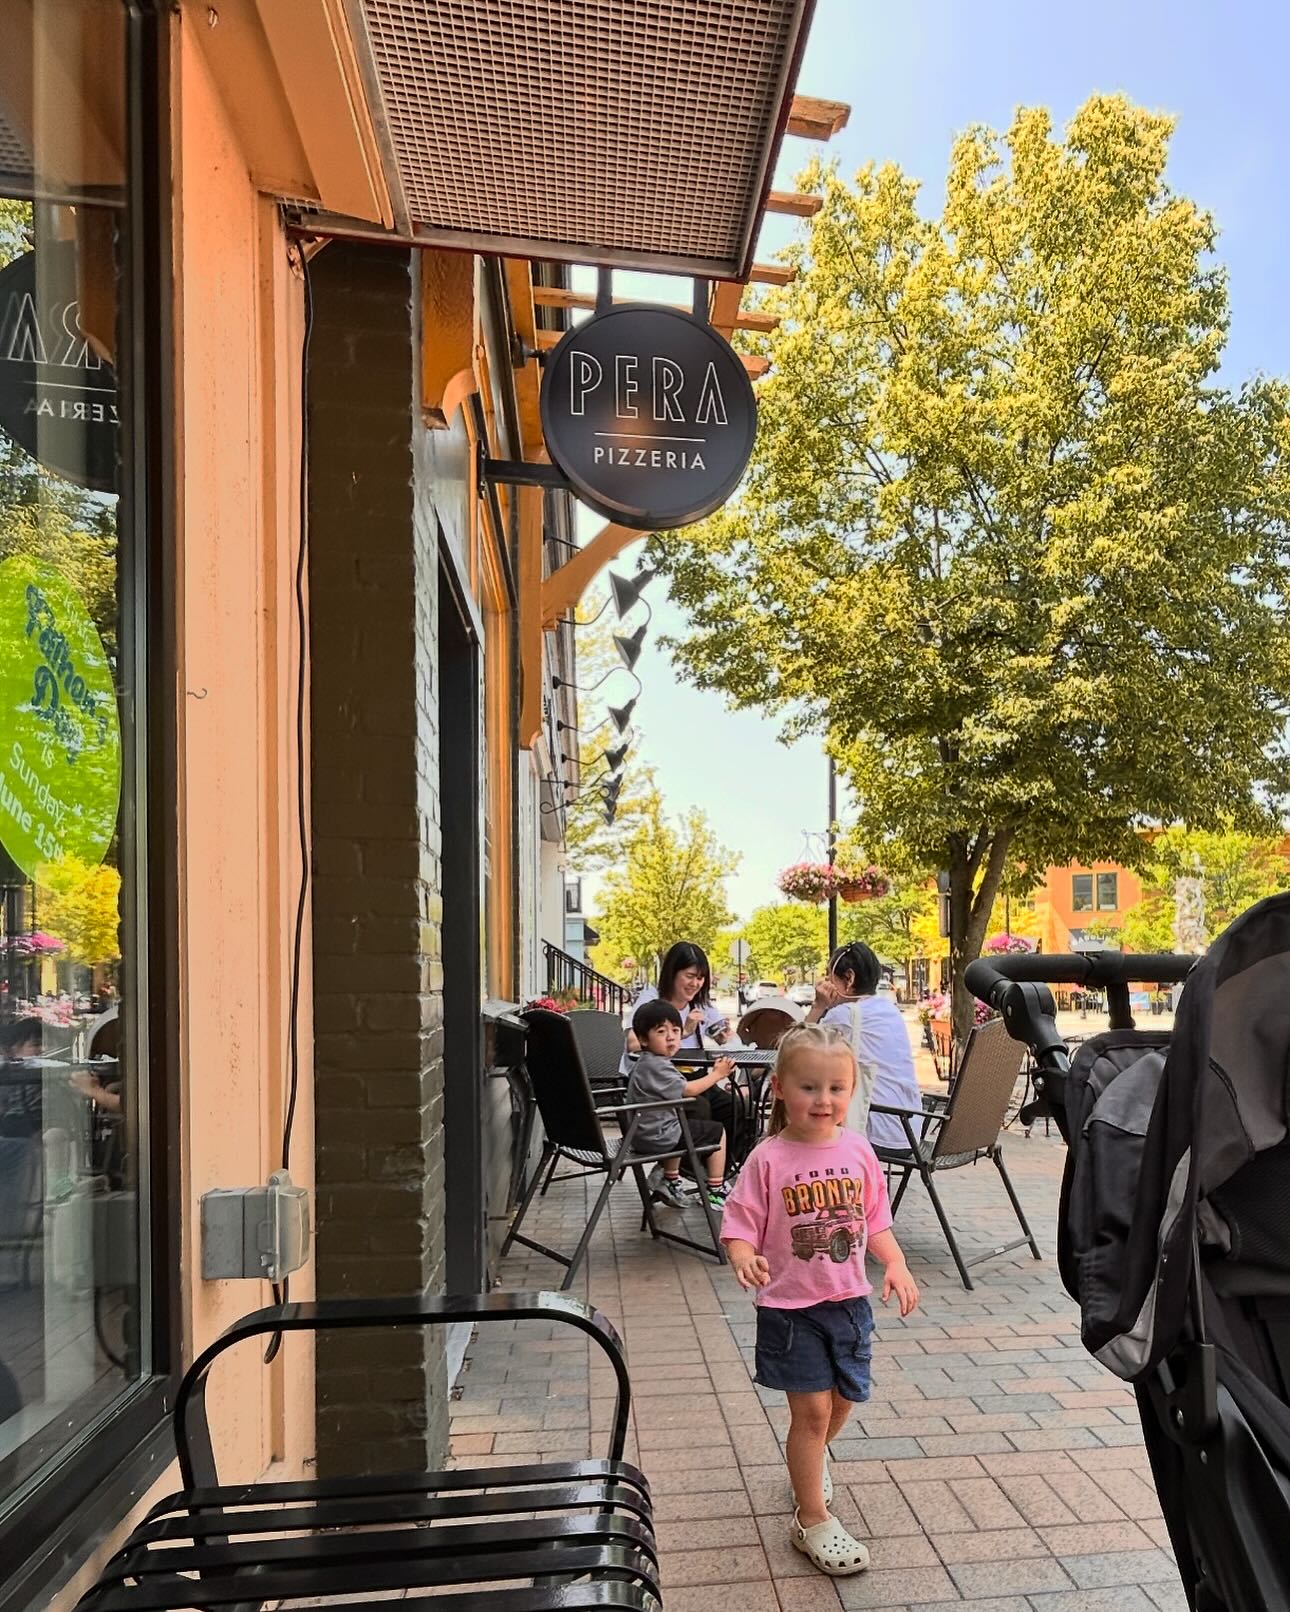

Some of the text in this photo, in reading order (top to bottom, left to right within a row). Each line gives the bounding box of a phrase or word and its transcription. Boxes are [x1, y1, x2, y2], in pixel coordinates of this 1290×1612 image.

[570, 350, 729, 425] PERA
[594, 447, 706, 471] PIZZERIA
[10, 741, 64, 828] Sunday
[794, 1168, 849, 1182] FORD
